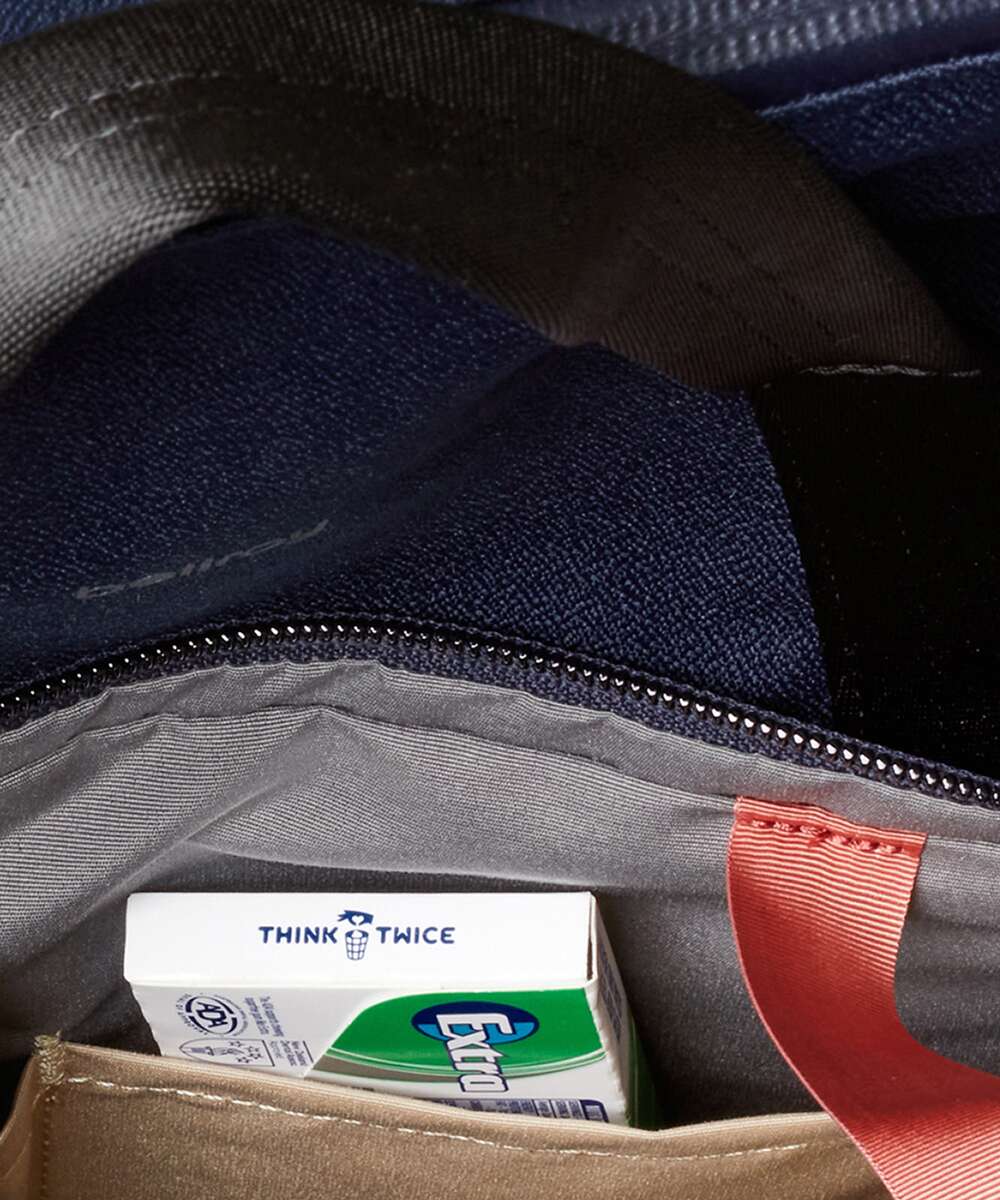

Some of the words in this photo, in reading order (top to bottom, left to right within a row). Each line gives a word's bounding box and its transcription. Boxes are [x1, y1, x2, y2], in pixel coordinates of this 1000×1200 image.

[258, 926, 338, 944] THINK
[375, 926, 456, 945] TWICE
[195, 1001, 229, 1028] ADA
[435, 1012, 514, 1093] Extra
